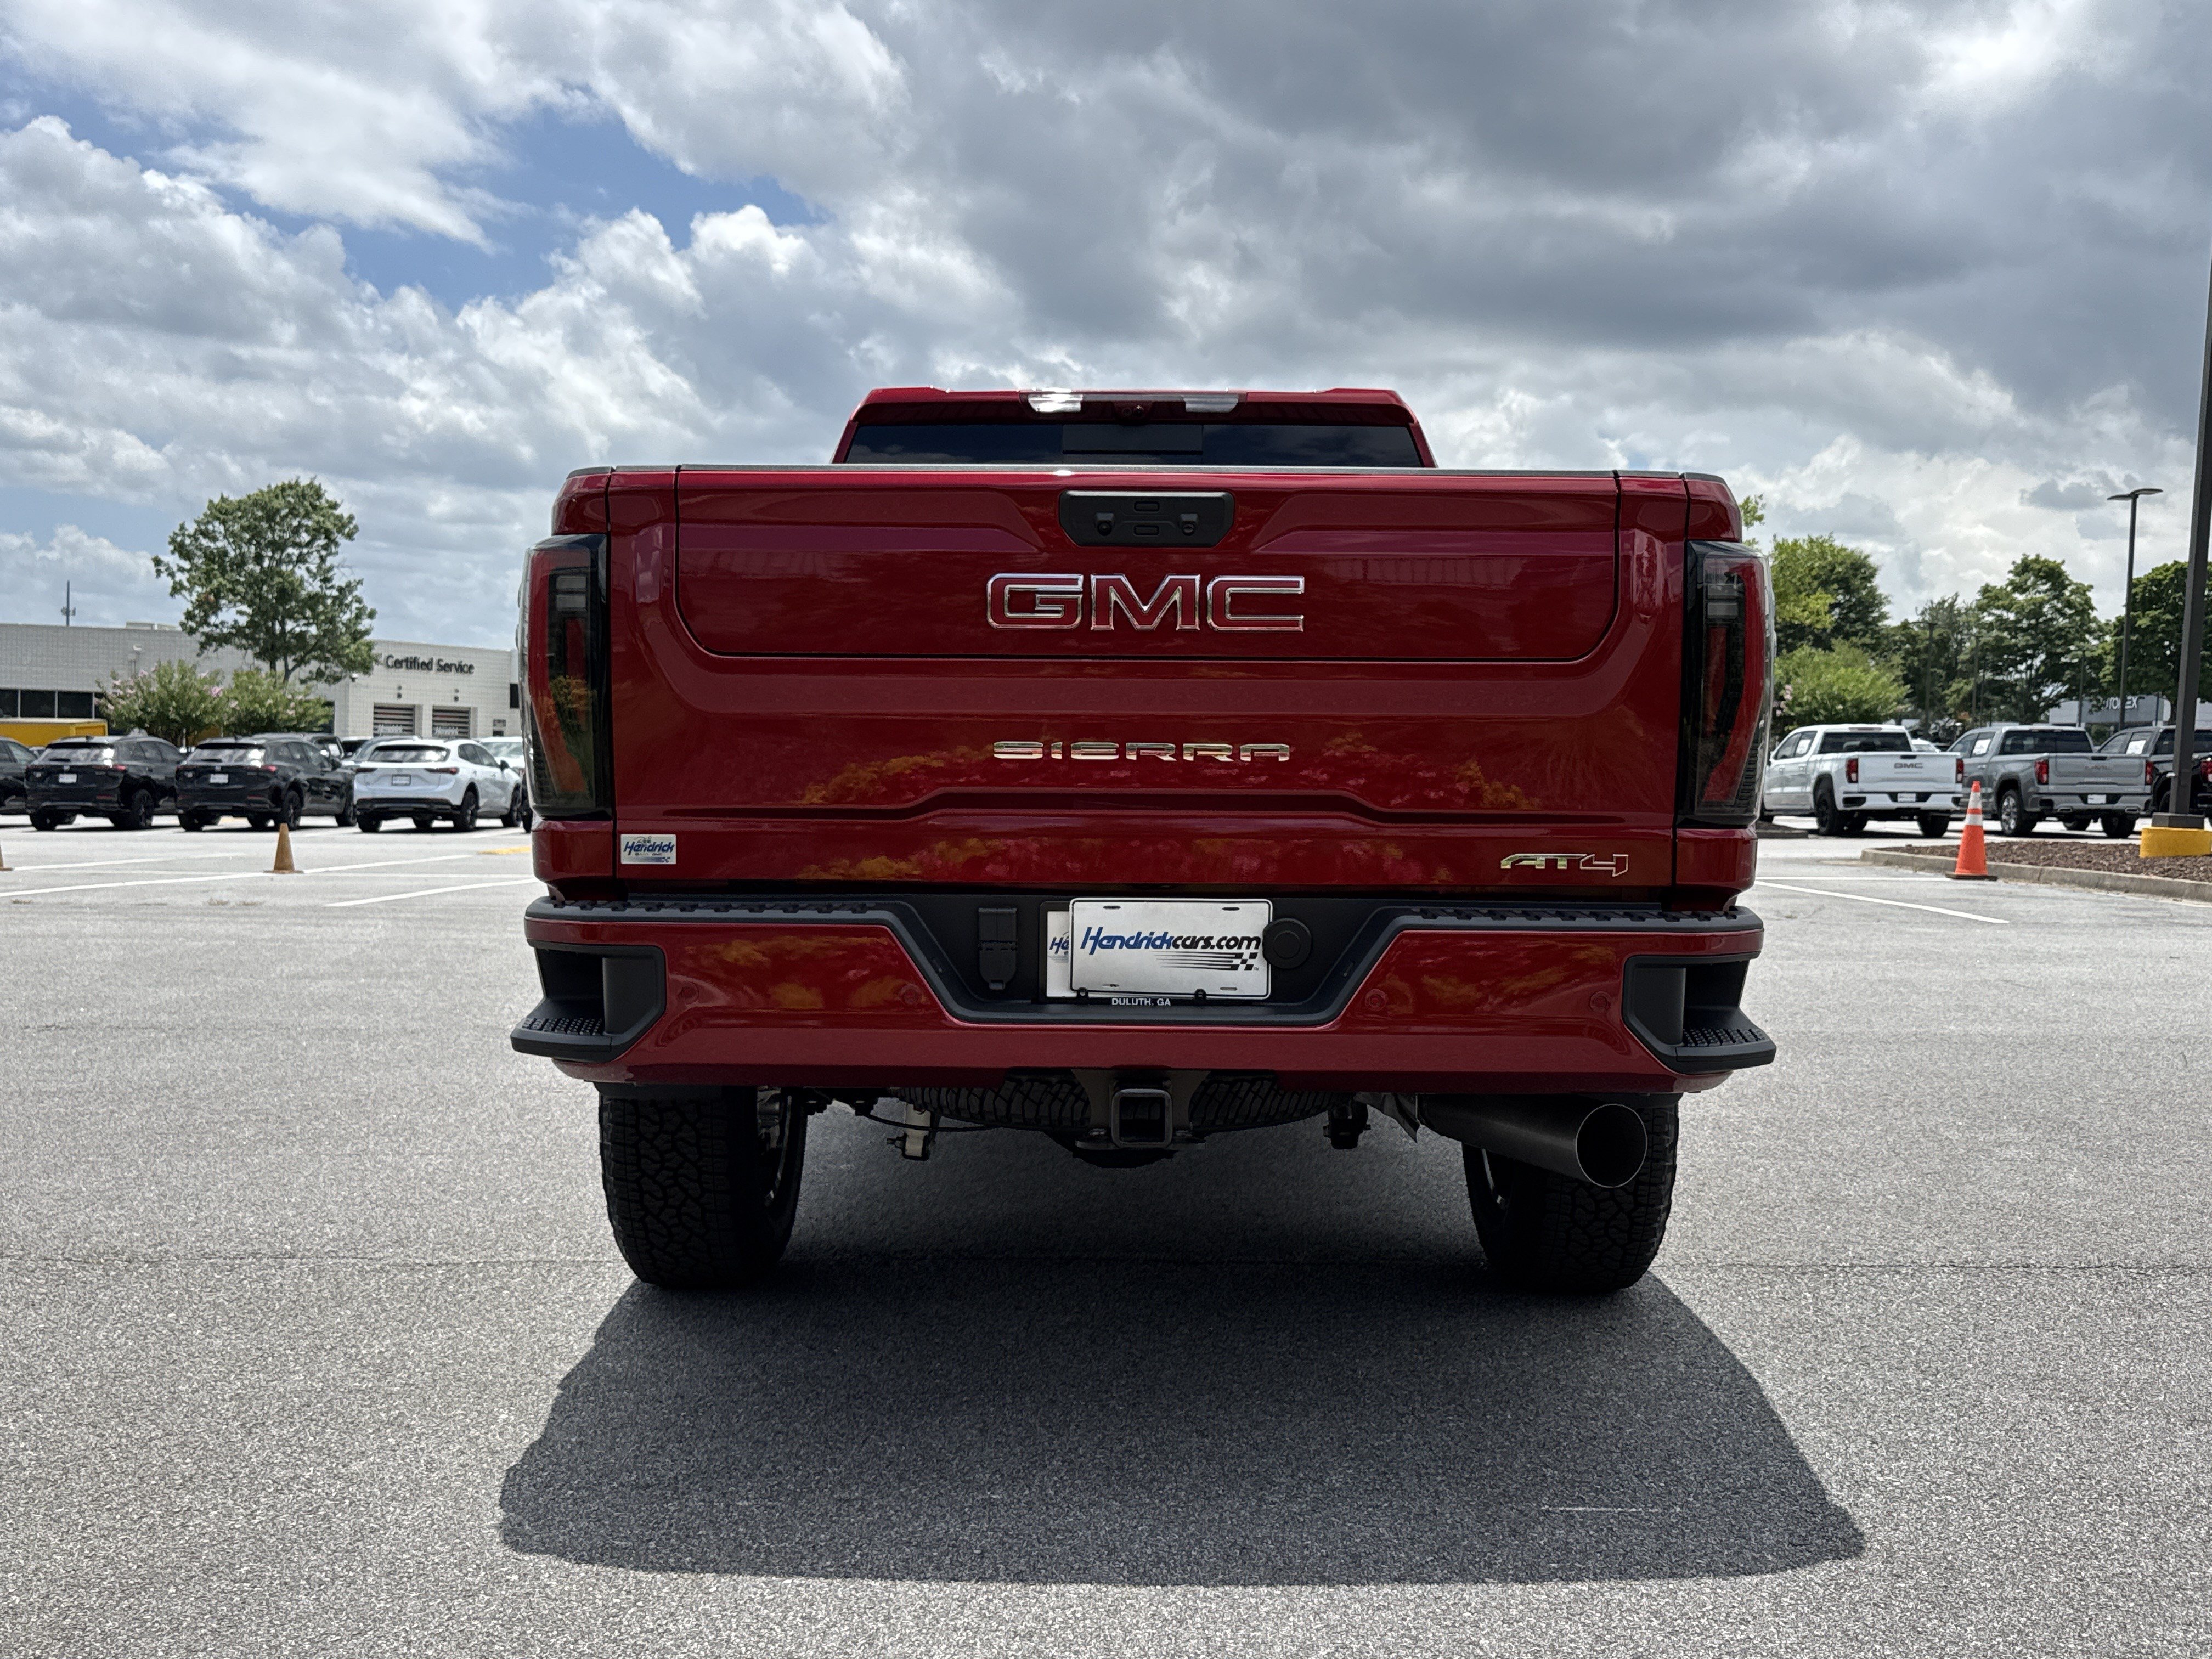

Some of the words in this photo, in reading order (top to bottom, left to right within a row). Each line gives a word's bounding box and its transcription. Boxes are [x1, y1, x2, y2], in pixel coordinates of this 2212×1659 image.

[986, 572, 1305, 633] GMC
[386, 654, 434, 670] Certified
[437, 658, 475, 674] Service
[993, 741, 1290, 762] SIERRA
[623, 841, 675, 855] Hendrick
[1500, 853, 1629, 877] AT4
[1080, 927, 1261, 955] Hendrickcars.com
[1156, 998, 1171, 1006] GA
